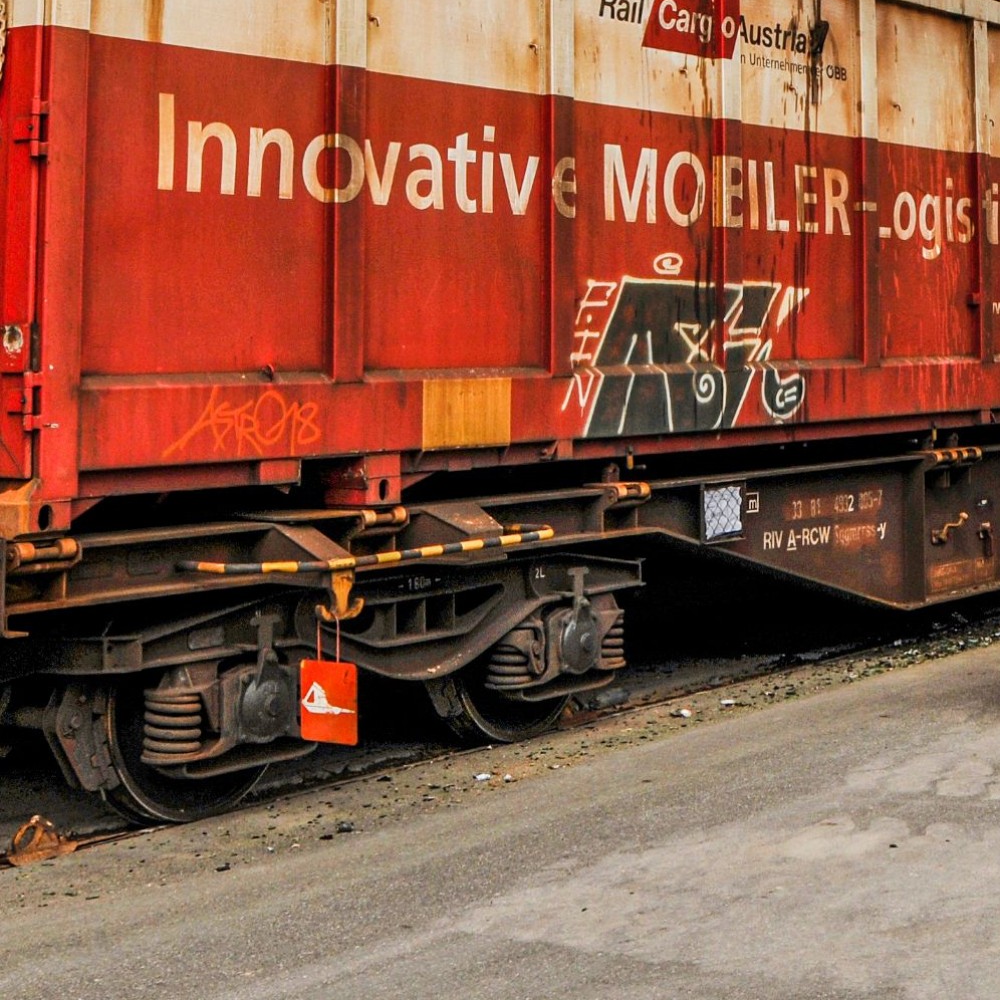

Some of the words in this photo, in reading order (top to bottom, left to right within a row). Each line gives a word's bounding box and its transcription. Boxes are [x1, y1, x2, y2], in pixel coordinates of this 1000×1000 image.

[740, 14, 807, 54] Austria
[157, 92, 577, 219] Innovative
[763, 530, 784, 550] RIV
[787, 524, 831, 551] A-RCW
